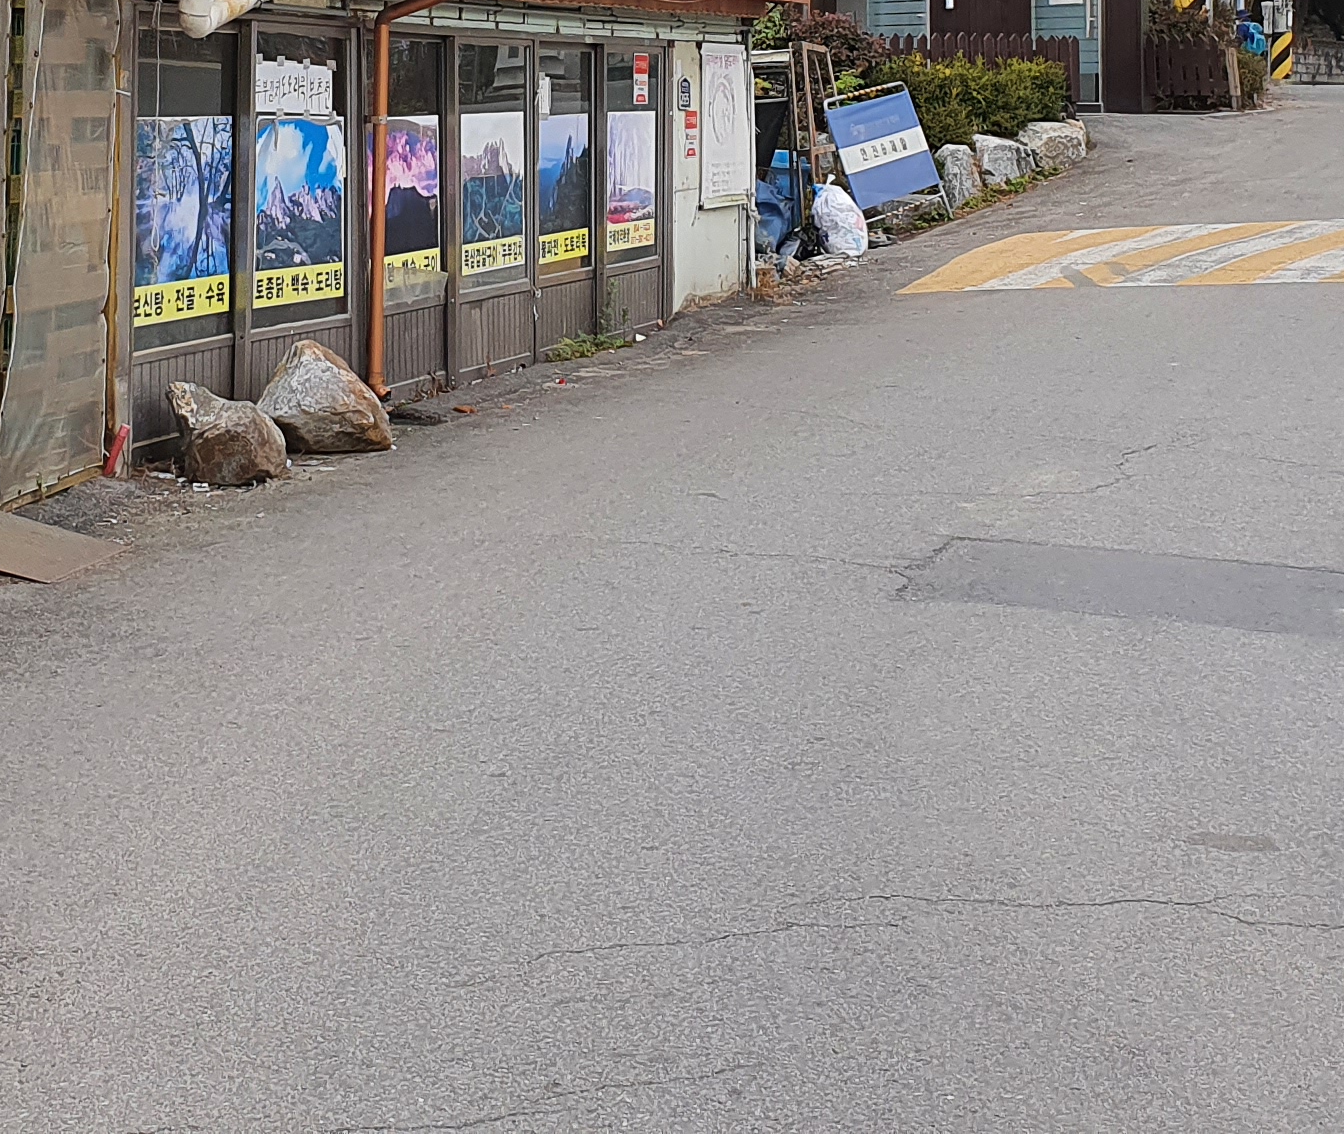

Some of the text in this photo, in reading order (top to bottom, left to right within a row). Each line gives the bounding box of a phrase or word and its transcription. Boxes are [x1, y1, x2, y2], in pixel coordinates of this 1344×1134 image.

[174, 284, 197, 312] 전골
[205, 281, 227, 308] 수육
[255, 270, 344, 300] 토종닭 백숙 도리탕
